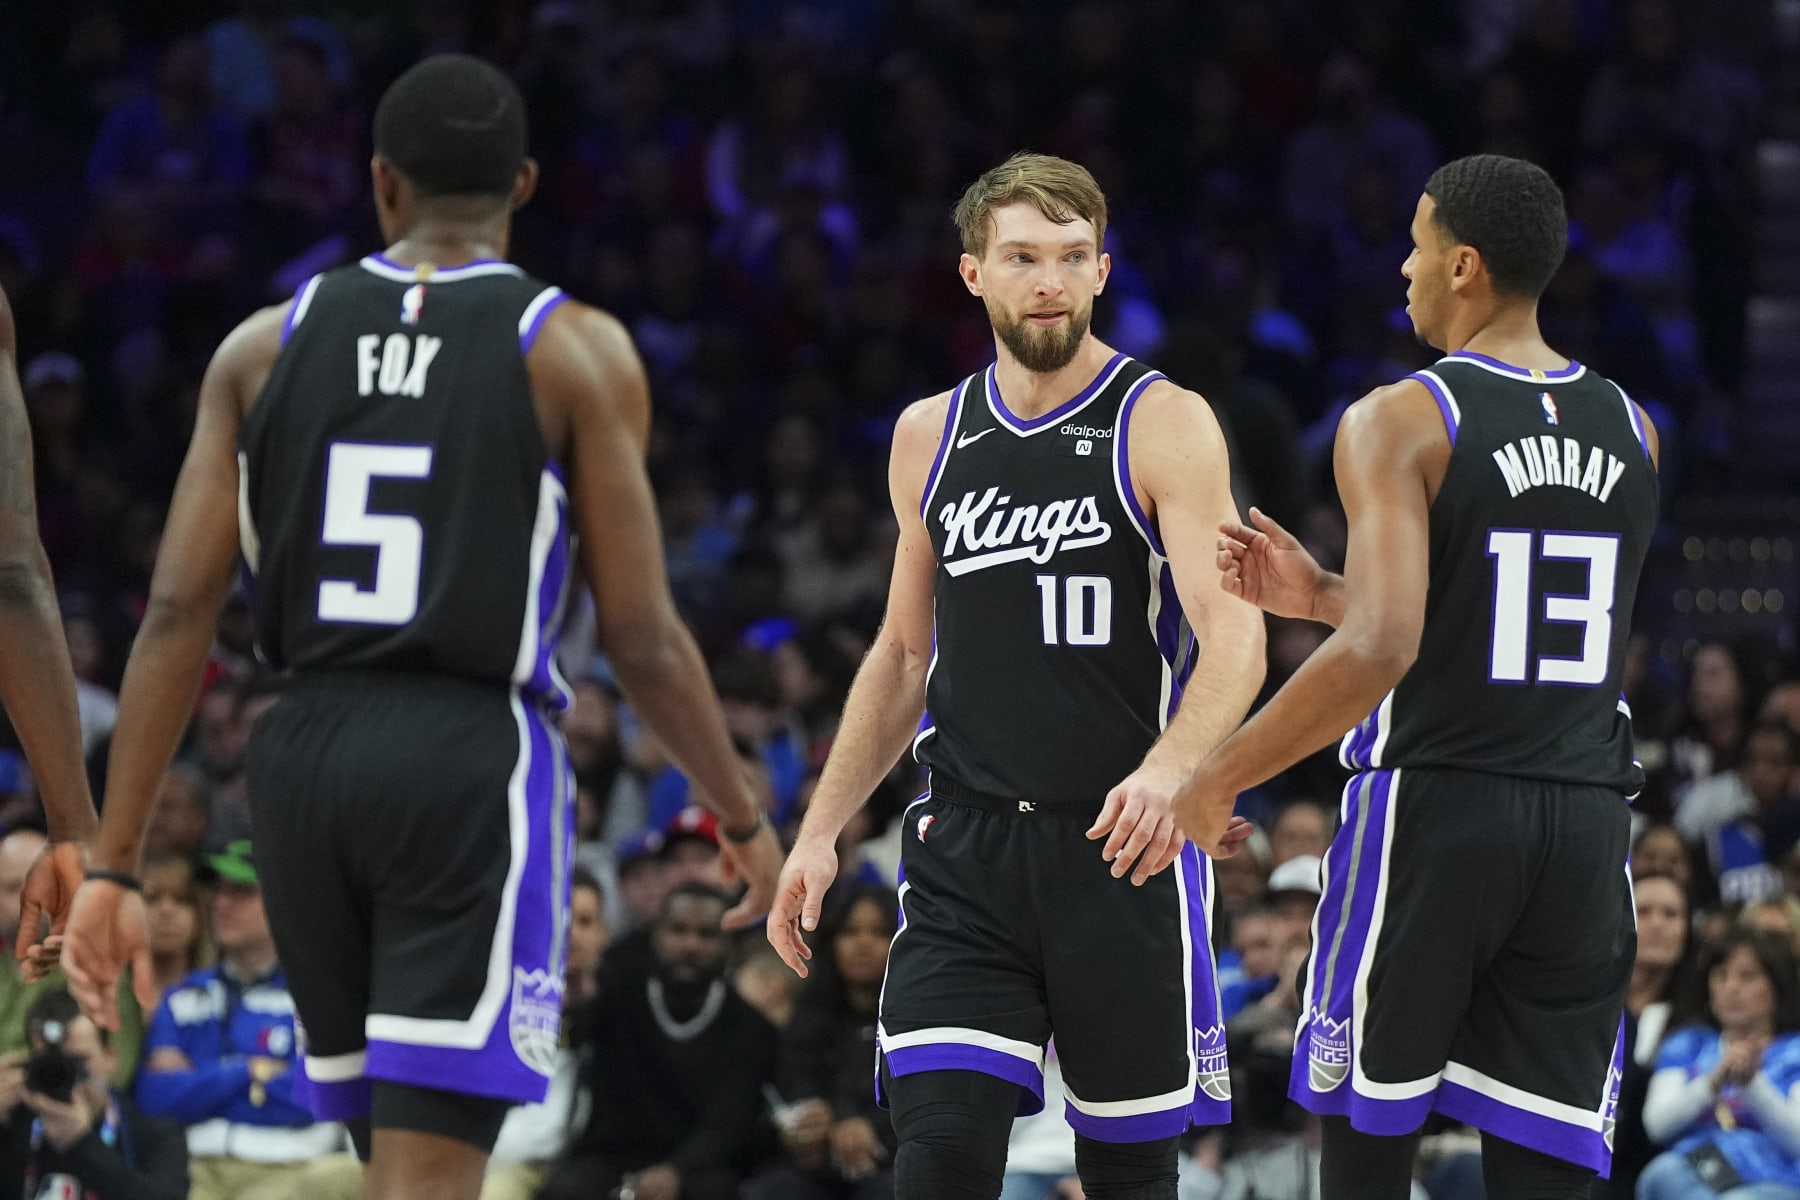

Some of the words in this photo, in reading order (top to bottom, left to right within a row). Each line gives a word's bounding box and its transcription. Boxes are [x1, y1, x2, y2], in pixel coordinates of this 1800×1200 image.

[357, 332, 442, 398] FOX
[1060, 423, 1113, 439] dialpad
[1492, 435, 1626, 503] MURRAY
[317, 441, 433, 625] 5
[939, 486, 1112, 577] Kings
[1035, 574, 1112, 646] 10
[1487, 529, 1620, 686] 13
[1198, 1055, 1227, 1073] KIN
